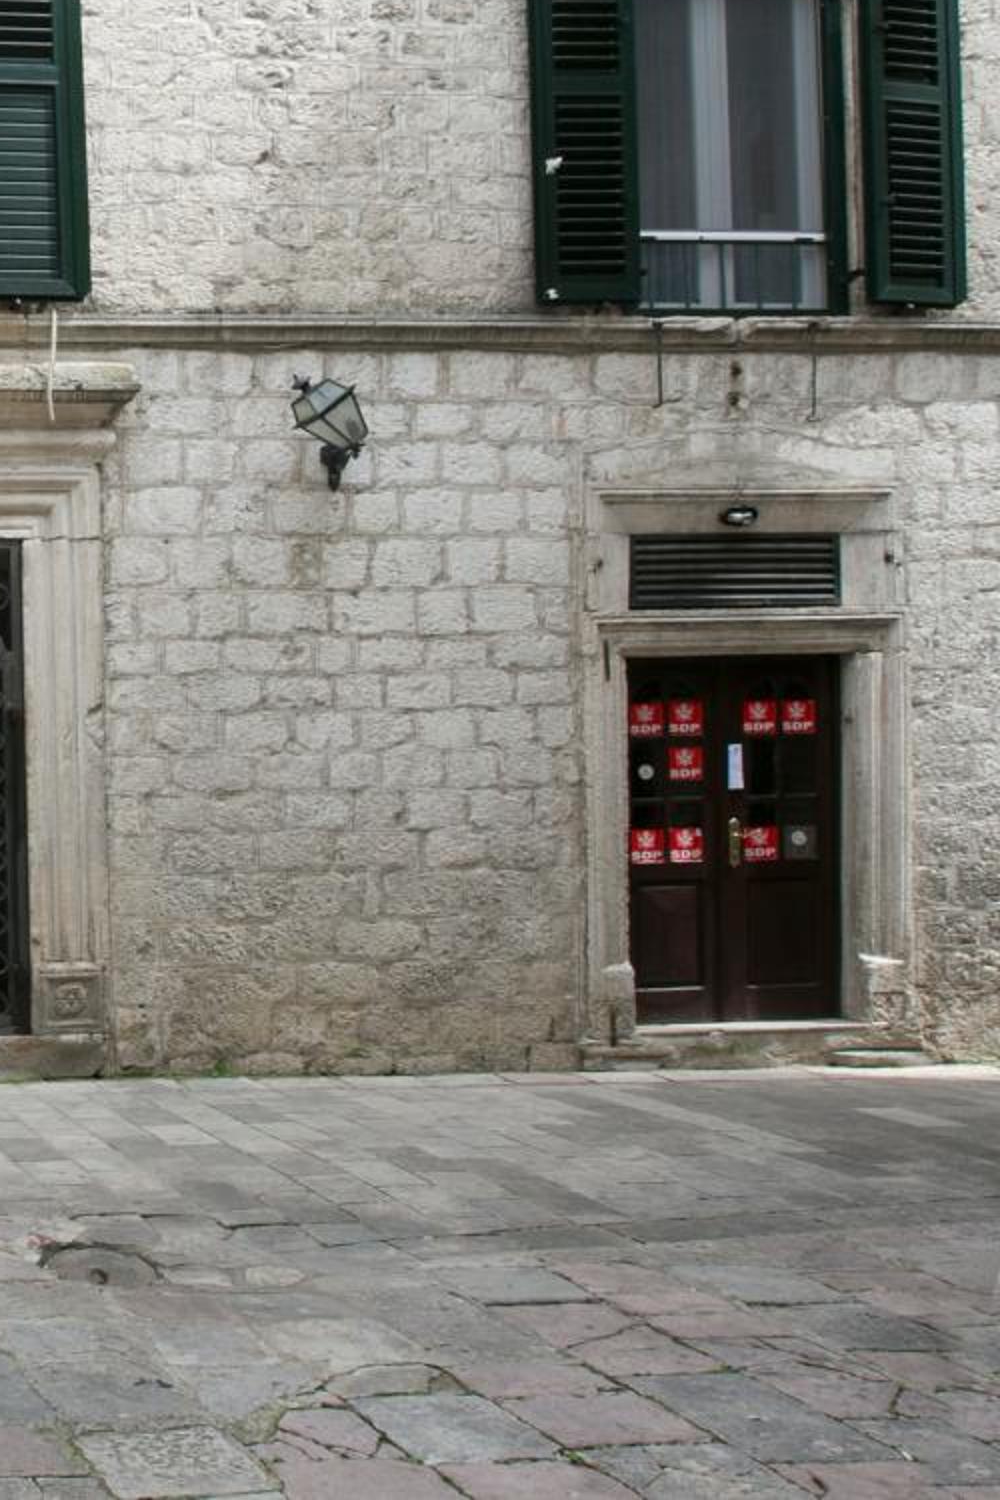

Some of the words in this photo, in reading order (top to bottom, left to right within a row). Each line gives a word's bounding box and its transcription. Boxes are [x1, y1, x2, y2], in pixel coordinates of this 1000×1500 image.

[631, 724, 662, 735] SDP
[668, 723, 701, 733] SDP
[743, 721, 775, 732] SDP
[782, 721, 814, 732] SDP
[669, 768, 702, 779] SDP
[631, 851, 664, 860] SDP
[744, 847, 776, 857] SDP
